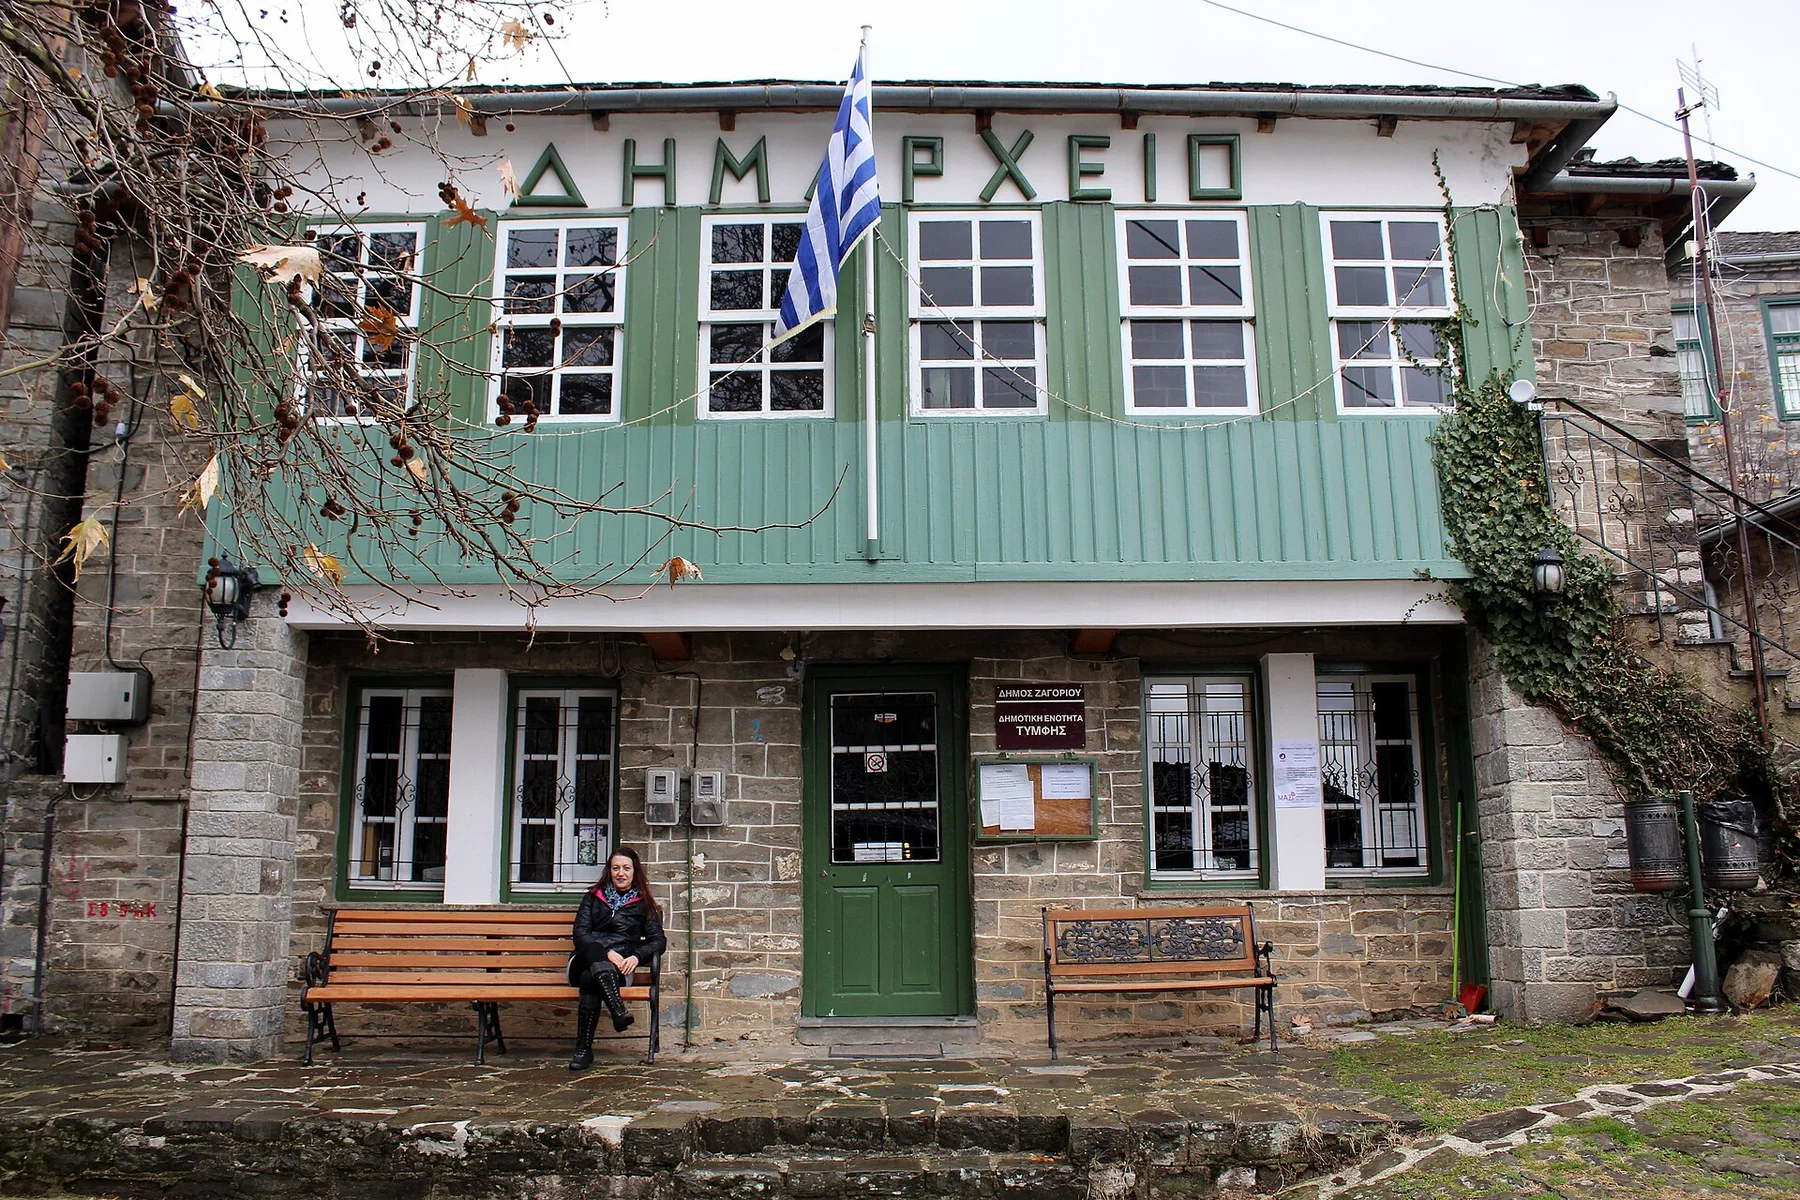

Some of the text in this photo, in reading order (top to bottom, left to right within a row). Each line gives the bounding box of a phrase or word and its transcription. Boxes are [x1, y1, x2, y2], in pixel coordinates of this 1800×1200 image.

[510, 127, 1242, 207] ΔΗΜΡΧΕΙΟ
[998, 688, 1082, 698] ΔΗΜΟΣ ΖΑΓΟΡΙΟΥ
[998, 714, 1084, 723] ΔΗΜΟΤΙΚΗ ΕΝΟΤΗΤΑ
[1016, 725, 1067, 736] ΤΥΜΦΗΣ
